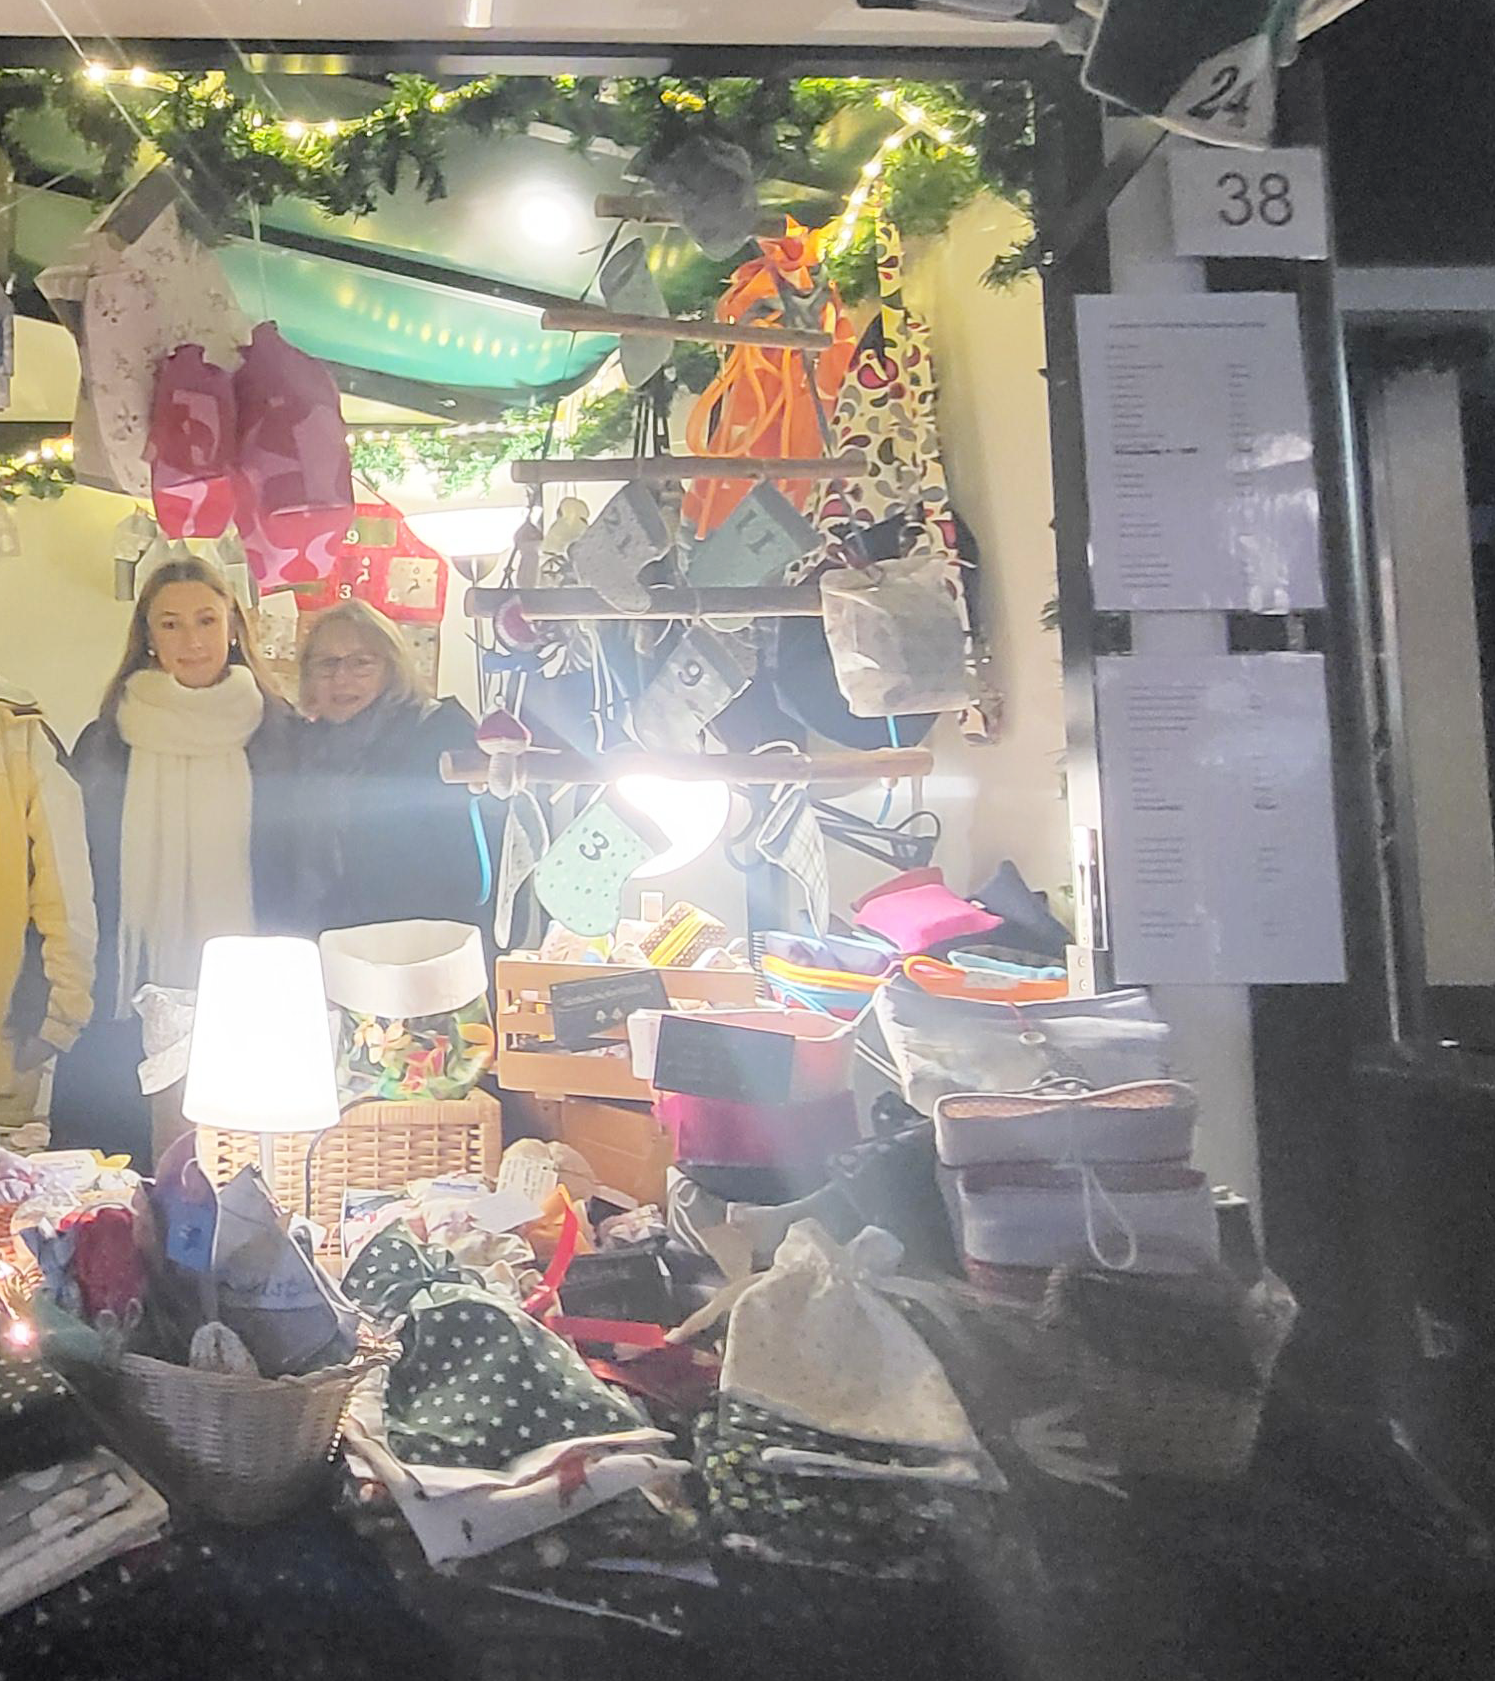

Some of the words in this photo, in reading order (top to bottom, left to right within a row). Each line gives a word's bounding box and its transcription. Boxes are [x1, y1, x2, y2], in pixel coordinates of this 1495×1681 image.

[1187, 65, 1256, 128] 24
[1217, 171, 1294, 226] 38
[339, 583, 353, 599] 3
[678, 659, 704, 687] 9
[578, 830, 610, 861] 3
